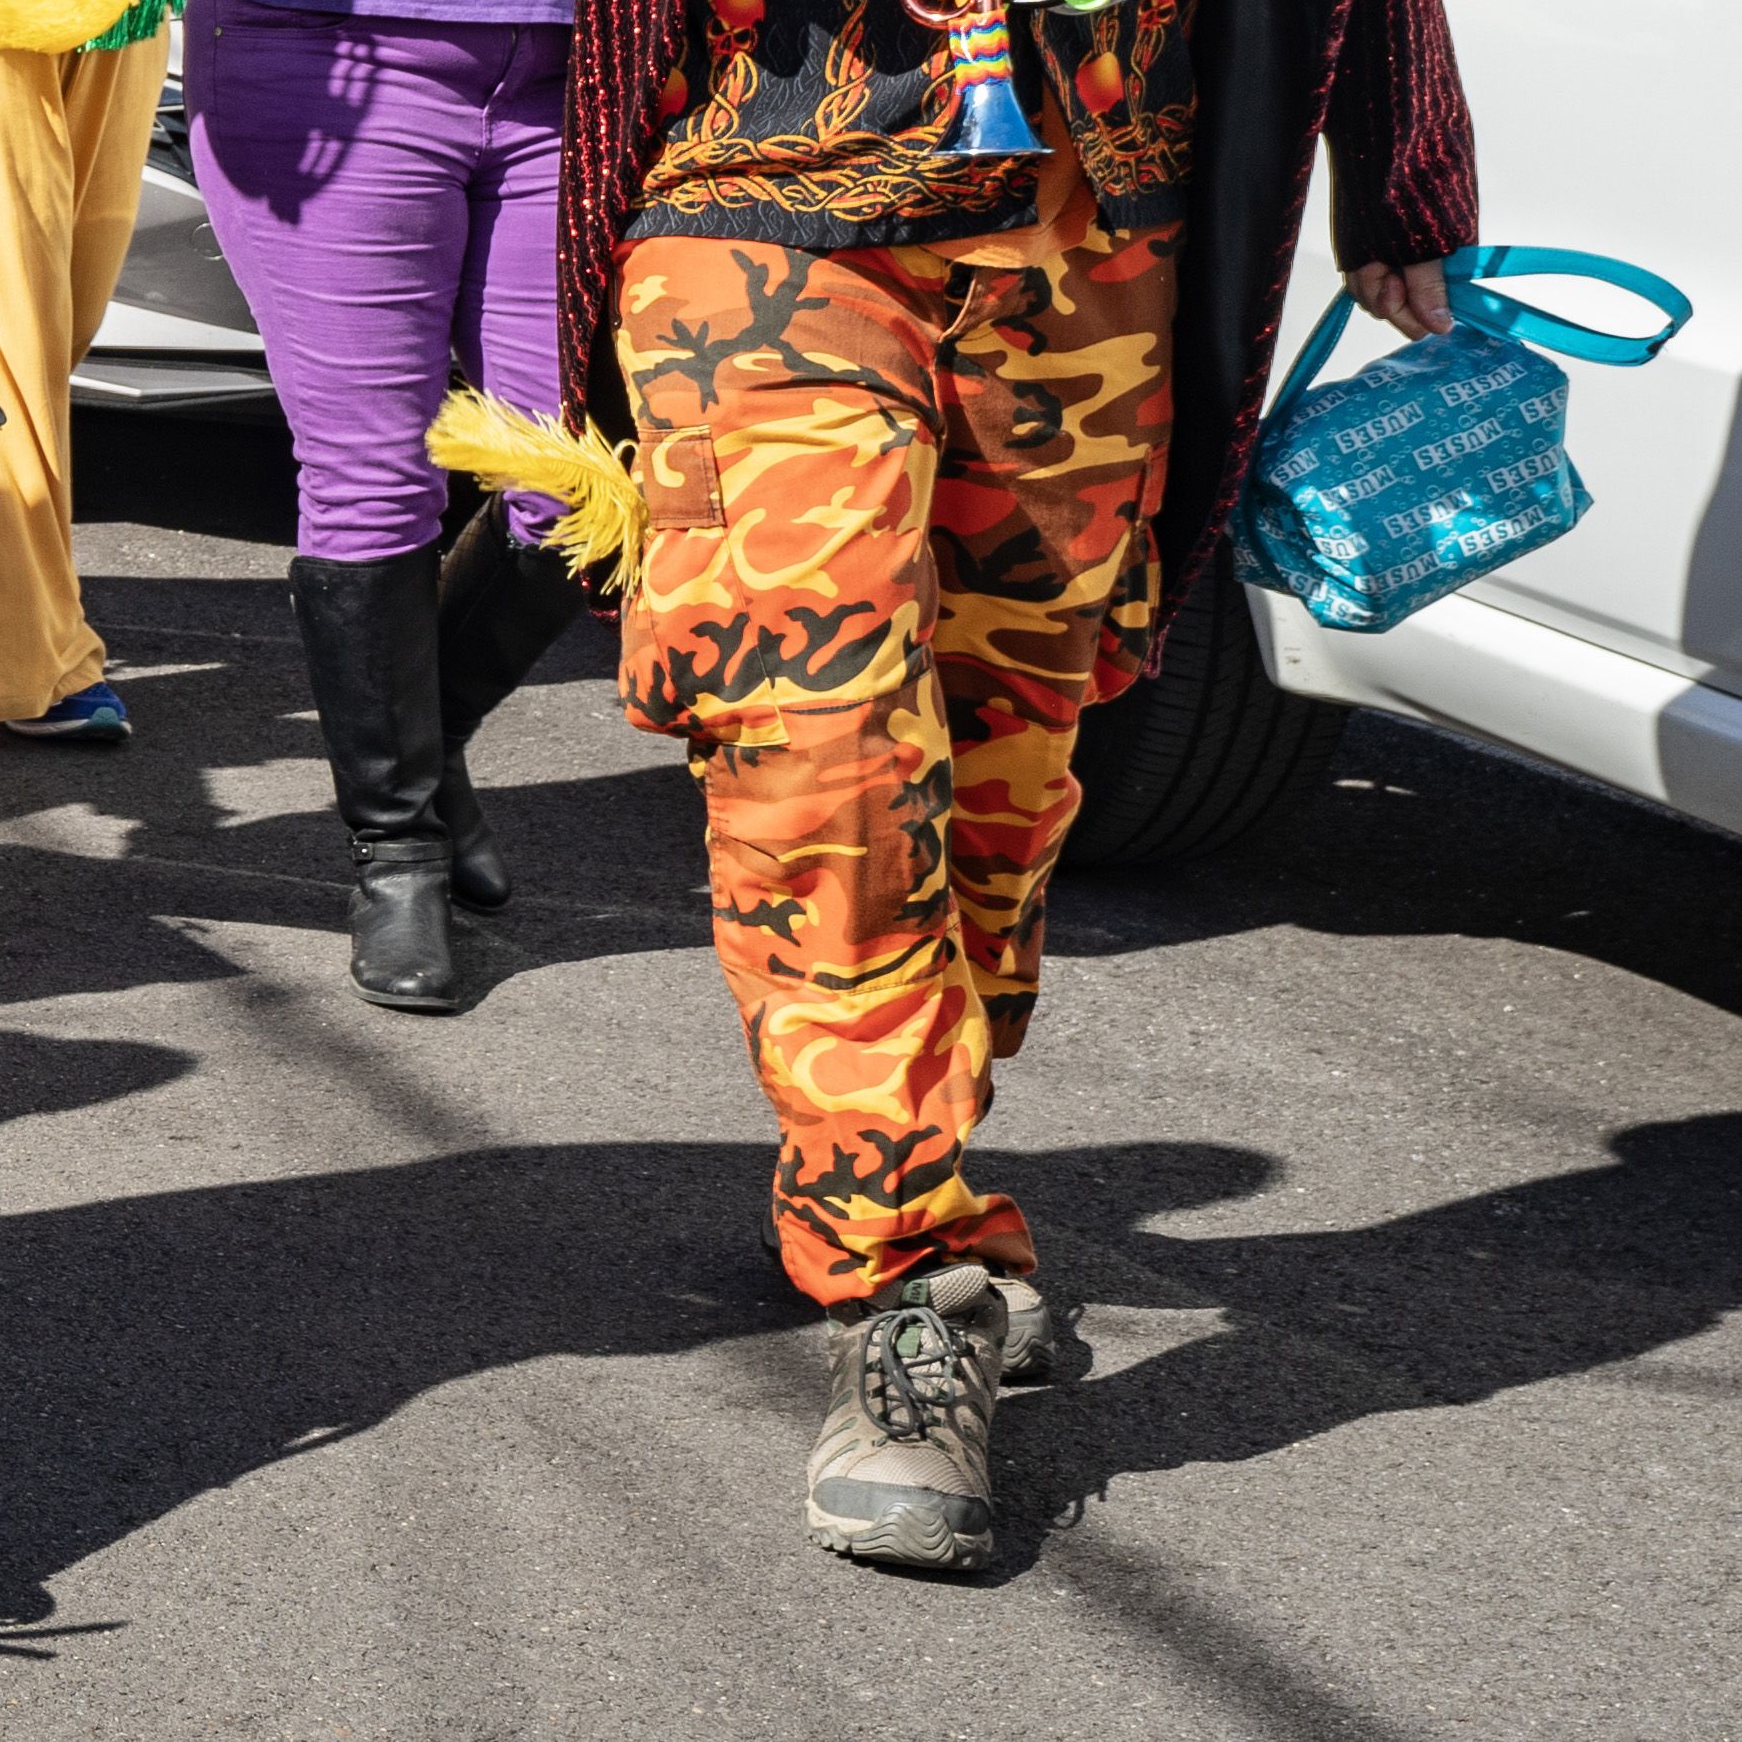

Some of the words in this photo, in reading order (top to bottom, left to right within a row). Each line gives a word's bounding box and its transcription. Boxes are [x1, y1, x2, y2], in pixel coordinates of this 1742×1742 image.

[1442, 362, 1525, 406] MUSES
[1339, 403, 1423, 453] MUSES
[1417, 419, 1503, 469] MUSES
[1273, 450, 1317, 484] MUS
[1387, 490, 1471, 537] MUSES
[1463, 507, 1544, 554] MUSES
[1321, 533, 1367, 557] MUS
[1362, 552, 1440, 592] MUSES
